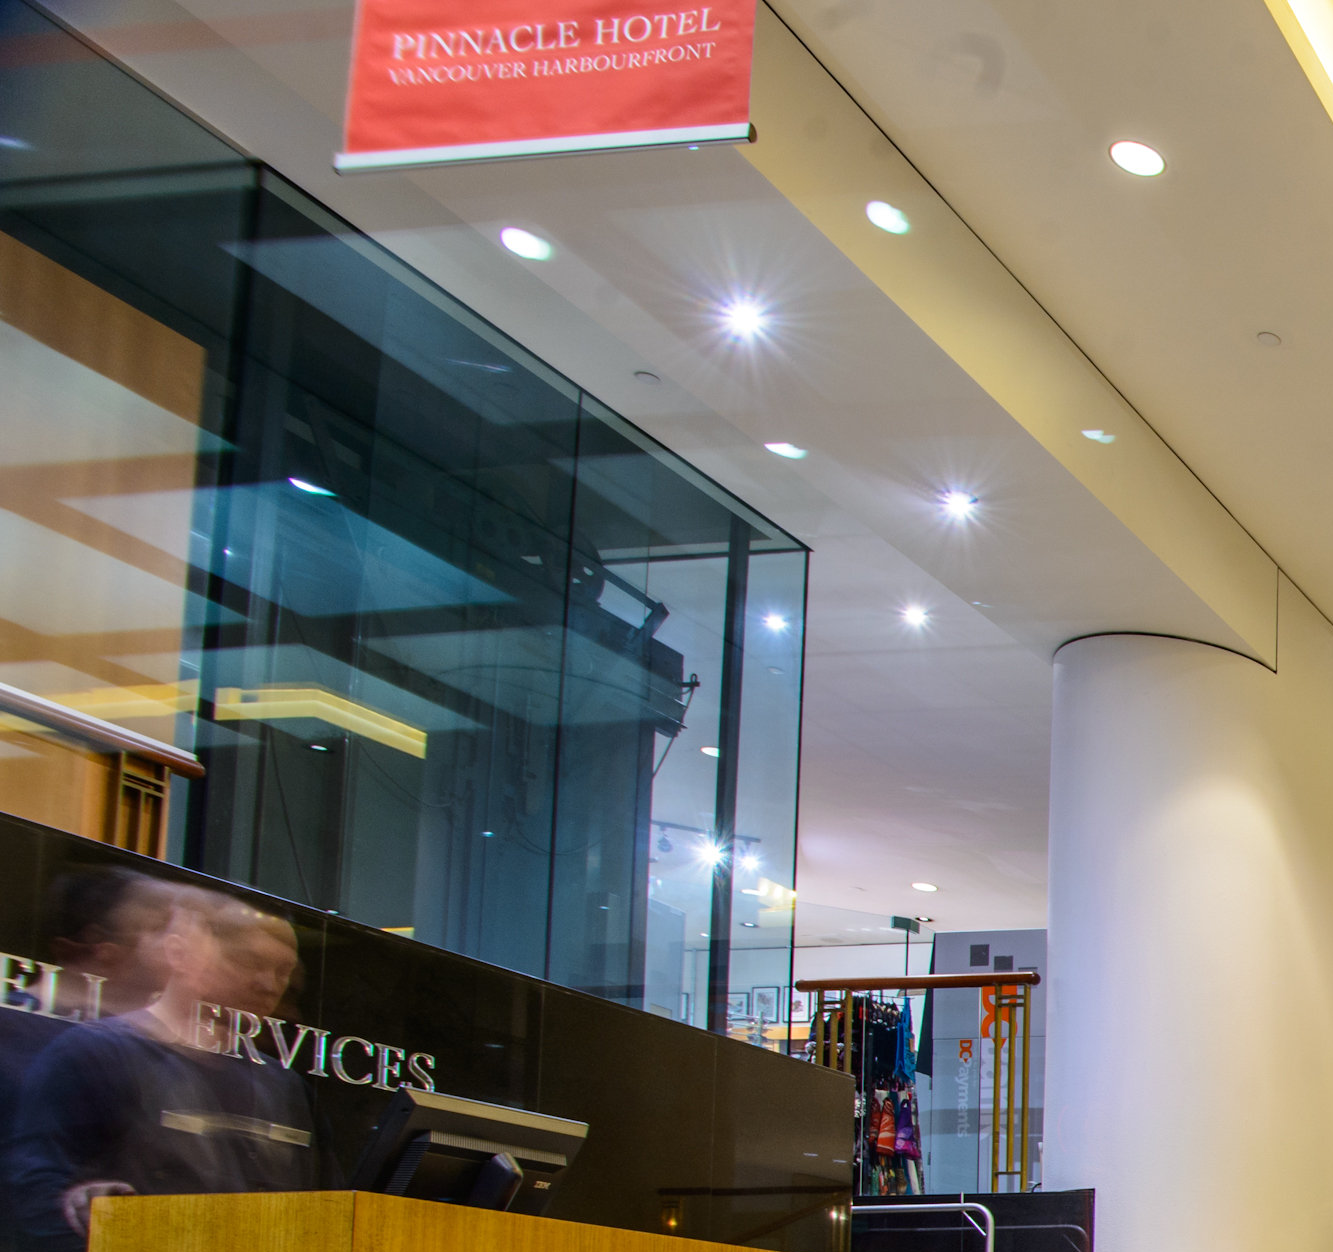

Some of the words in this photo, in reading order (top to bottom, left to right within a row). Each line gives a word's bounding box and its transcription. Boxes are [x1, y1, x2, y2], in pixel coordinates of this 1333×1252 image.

[393, 21, 581, 60] PINNACLE
[595, 7, 721, 45] HOTEL
[387, 61, 526, 86] VANCOUVER
[532, 41, 716, 77] HARBOURFRONT
[185, 1000, 436, 1093] ERVICES
